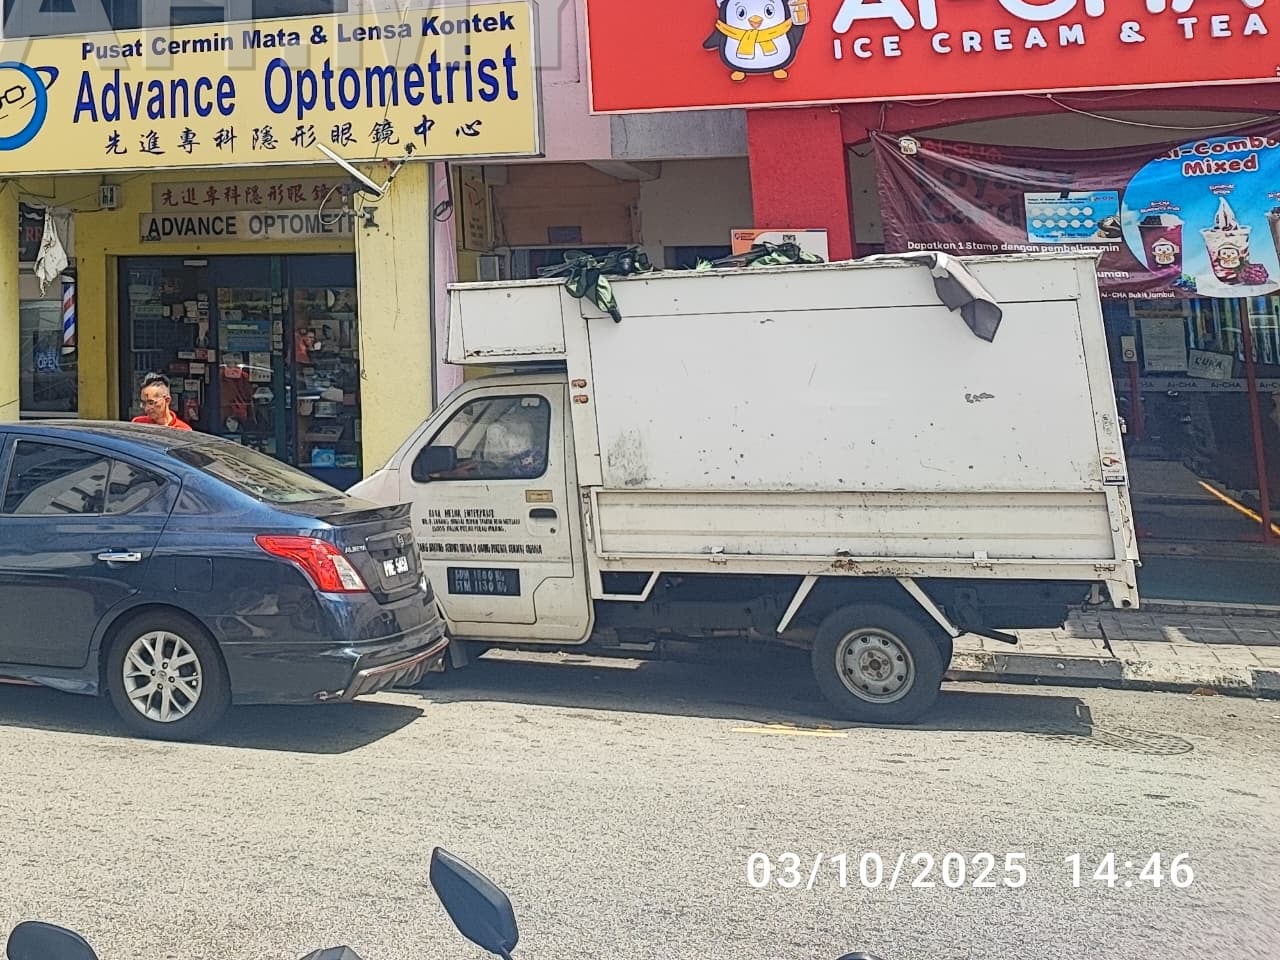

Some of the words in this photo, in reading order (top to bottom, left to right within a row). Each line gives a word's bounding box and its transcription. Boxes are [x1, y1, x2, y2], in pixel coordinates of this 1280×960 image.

[82, 40, 143, 60] Pusat
[151, 31, 234, 56] Cermin
[242, 28, 300, 49] Mata
[310, 24, 328, 44] &
[338, 19, 412, 42] Lensa
[421, 10, 516, 38] Kontek
[833, 35, 902, 60] ICE
[931, 23, 1086, 54] CREAM
[1120, 21, 1145, 43] &
[1177, 13, 1268, 40] TEA
[73, 69, 236, 124] Advance
[264, 42, 519, 121] Optometrist
[1183, 154, 1258, 176] Mixed
[148, 214, 237, 237] ADVANCE
[907, 241, 957, 253] Dapatkan
[965, 242, 998, 252] Stamp
[1001, 242, 1038, 253] dengan
[1099, 244, 1120, 252] min
